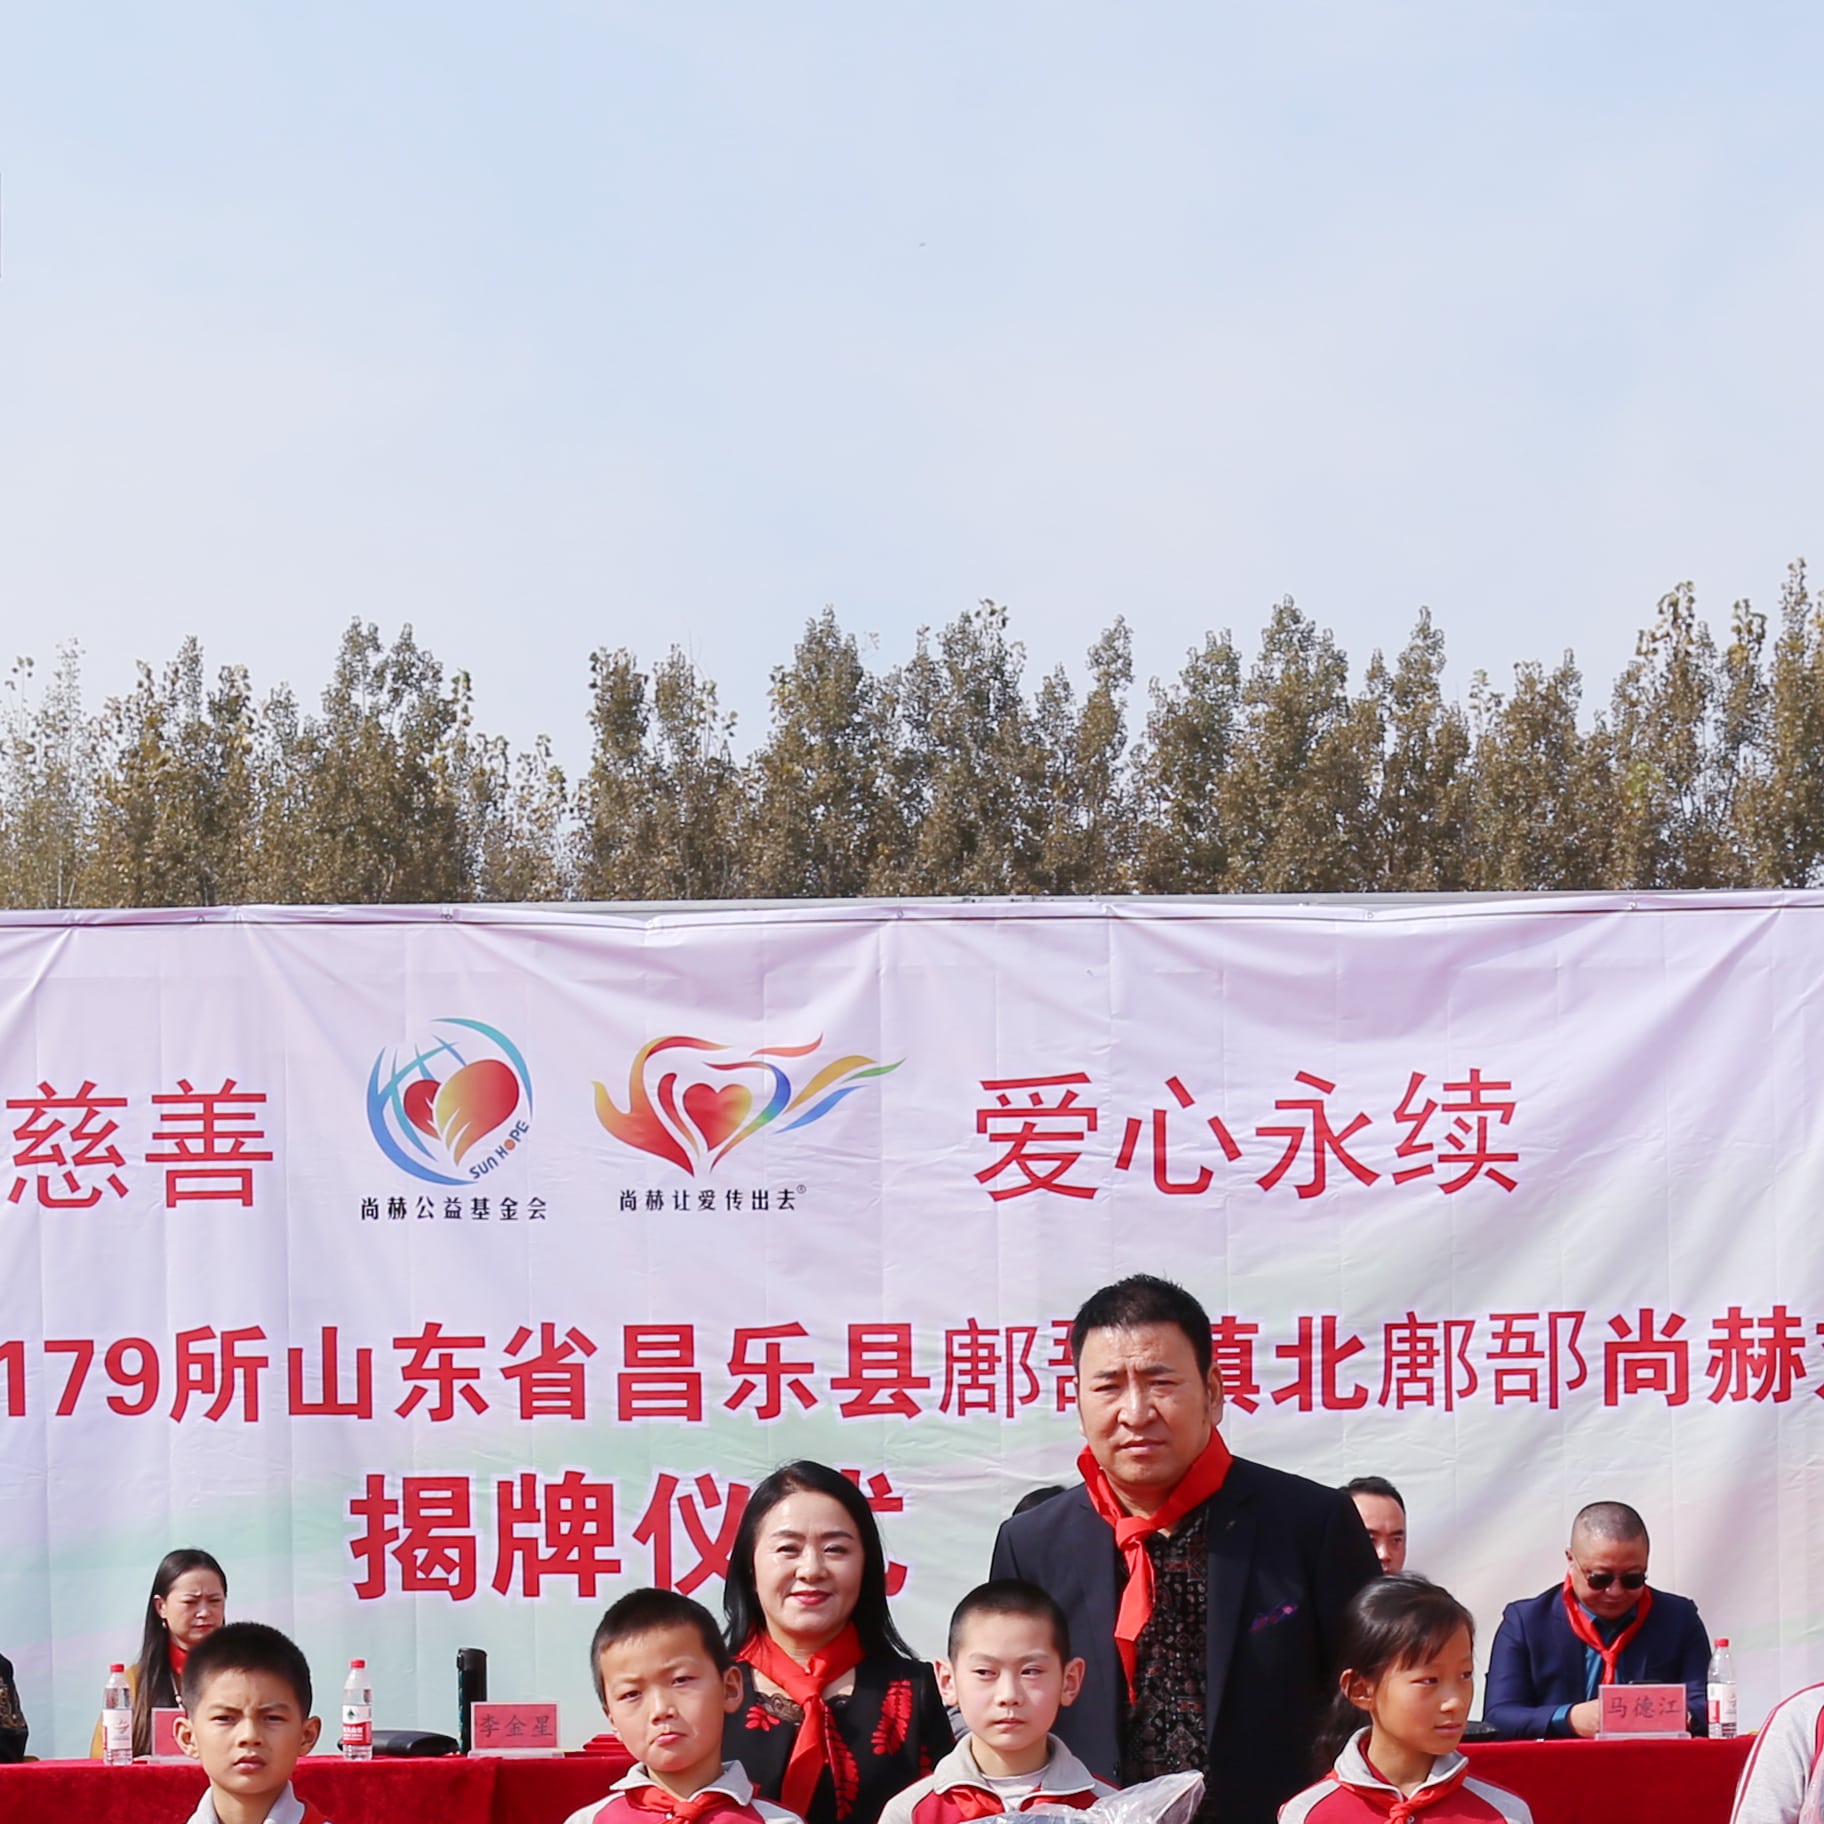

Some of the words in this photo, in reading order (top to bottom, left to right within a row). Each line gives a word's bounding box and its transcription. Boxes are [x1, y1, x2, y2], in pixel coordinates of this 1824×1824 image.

[974, 1068, 1520, 1203] 爱心永续
[360, 1196, 547, 1221] 尚赫公益基金会
[619, 1187, 797, 1212] 尚赫让爱传出去
[1607, 1697, 1681, 1719] 马德江
[479, 1713, 553, 1738] 李金星
